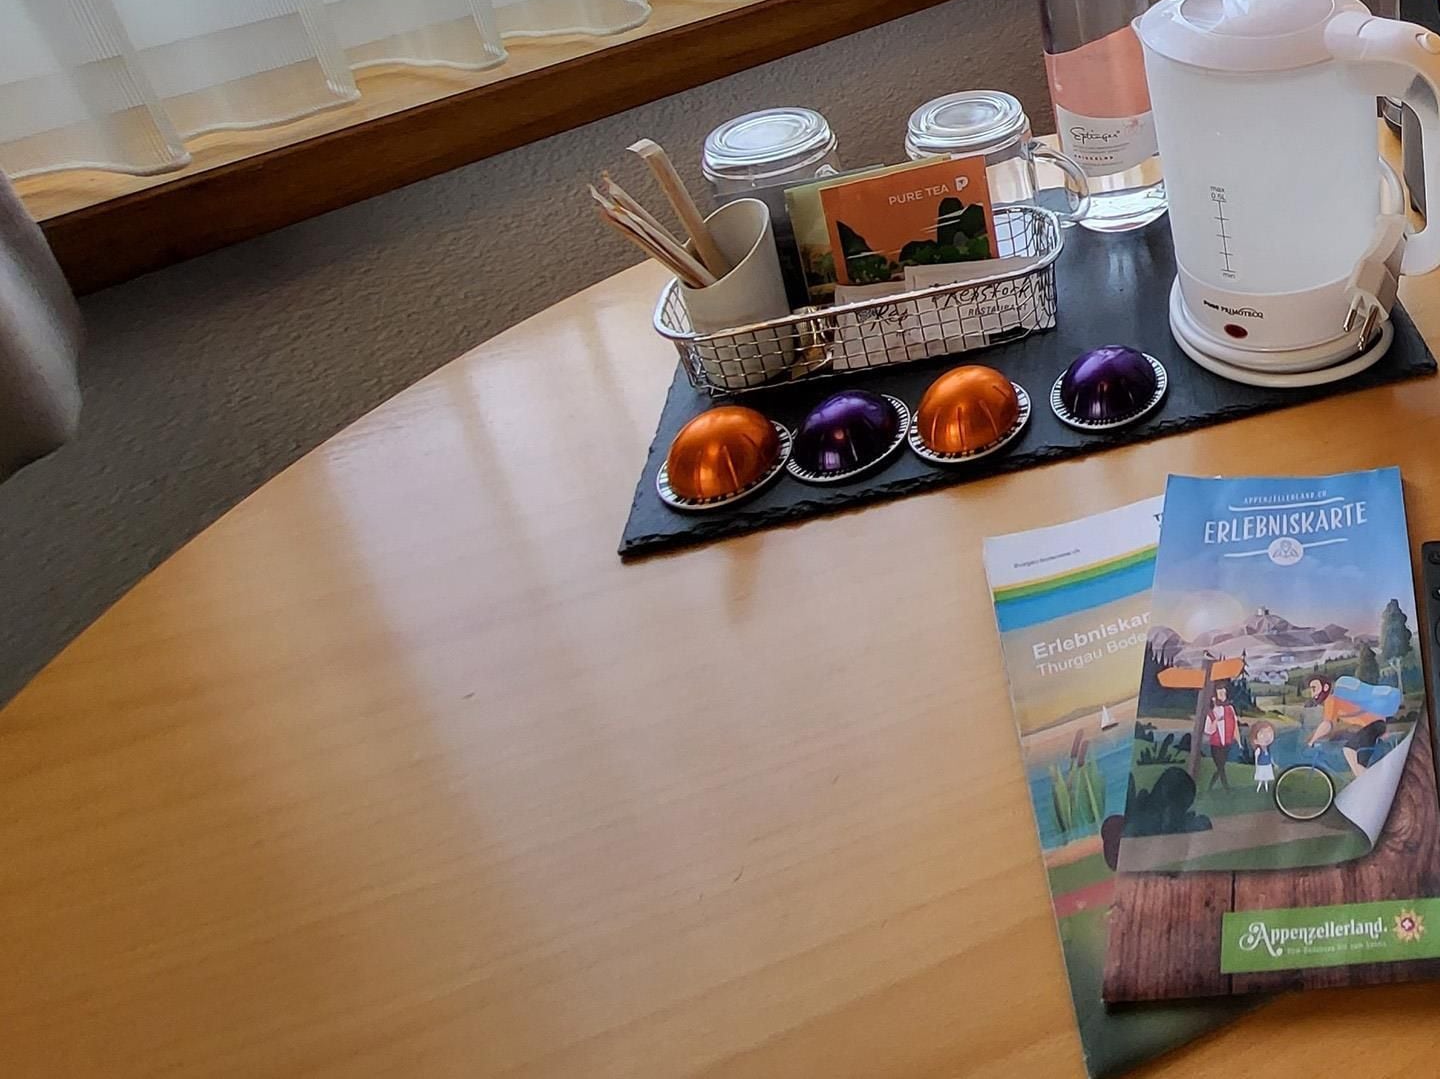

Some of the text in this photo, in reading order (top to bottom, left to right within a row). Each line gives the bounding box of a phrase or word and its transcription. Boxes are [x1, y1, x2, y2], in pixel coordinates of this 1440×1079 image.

[888, 190, 924, 206] PURE
[925, 184, 949, 197] TEA
[1203, 501, 1368, 545] ERLEBNISKARTE
[1036, 648, 1103, 677] Thurgau
